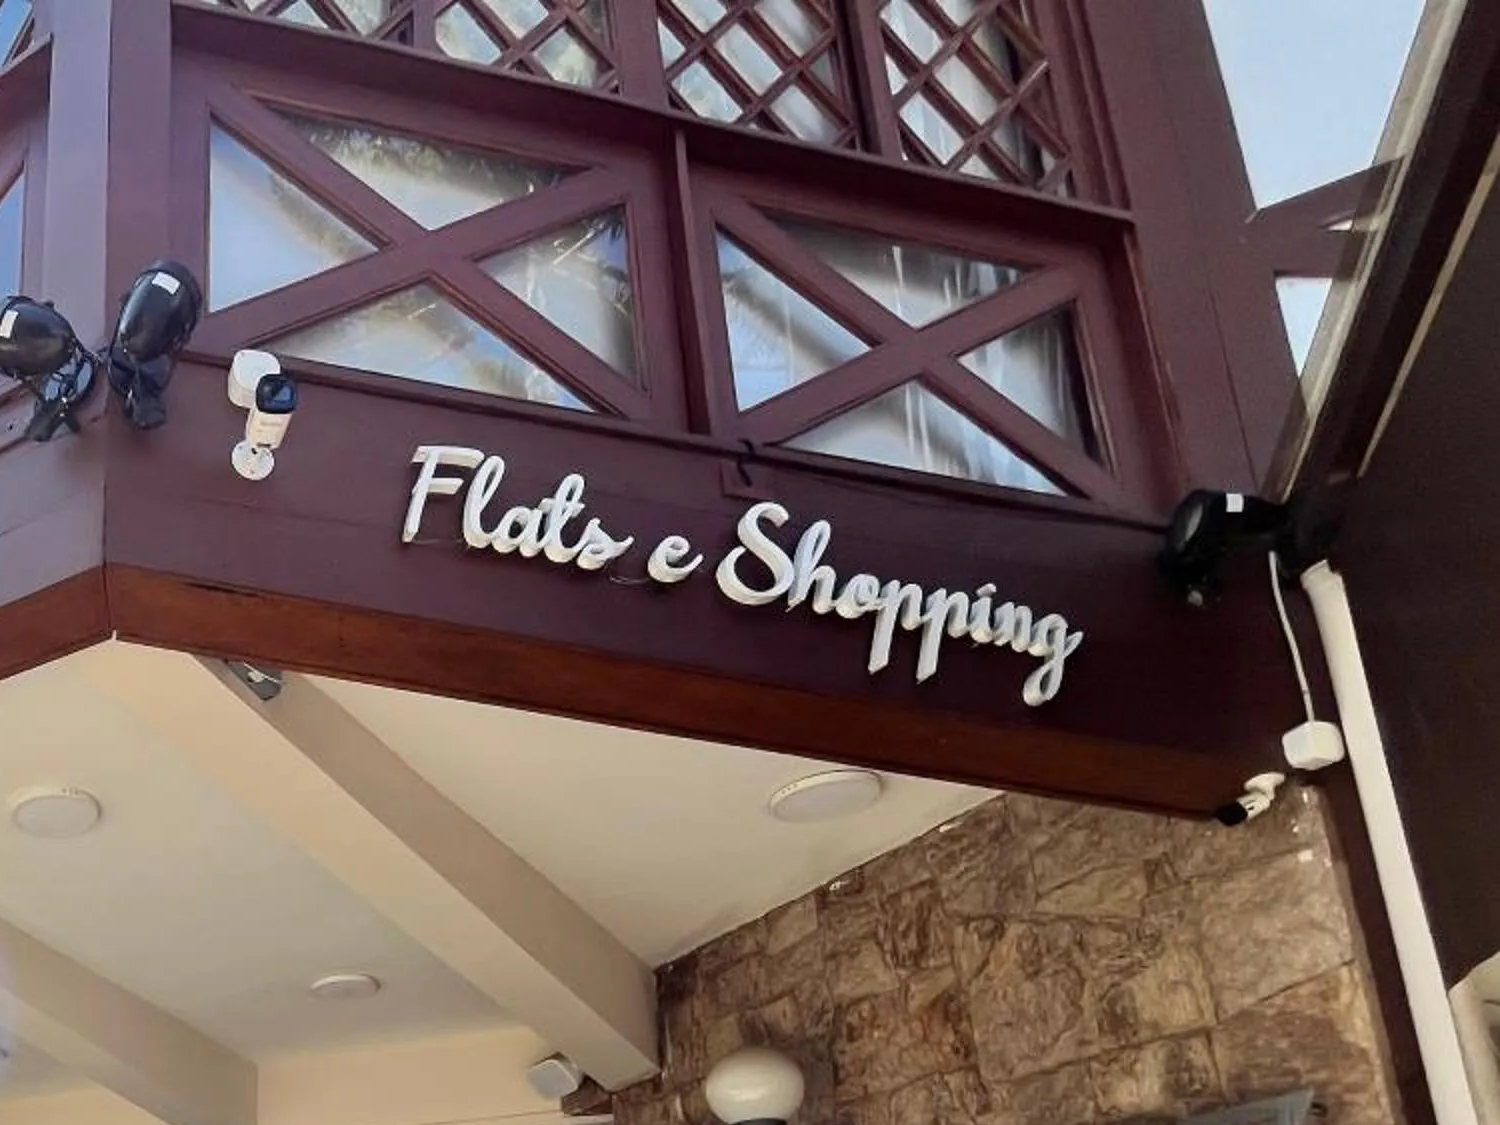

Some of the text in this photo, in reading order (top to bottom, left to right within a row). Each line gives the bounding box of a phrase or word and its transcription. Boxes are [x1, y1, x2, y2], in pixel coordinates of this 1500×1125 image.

[400, 445, 1084, 707] Flats e Shopping
